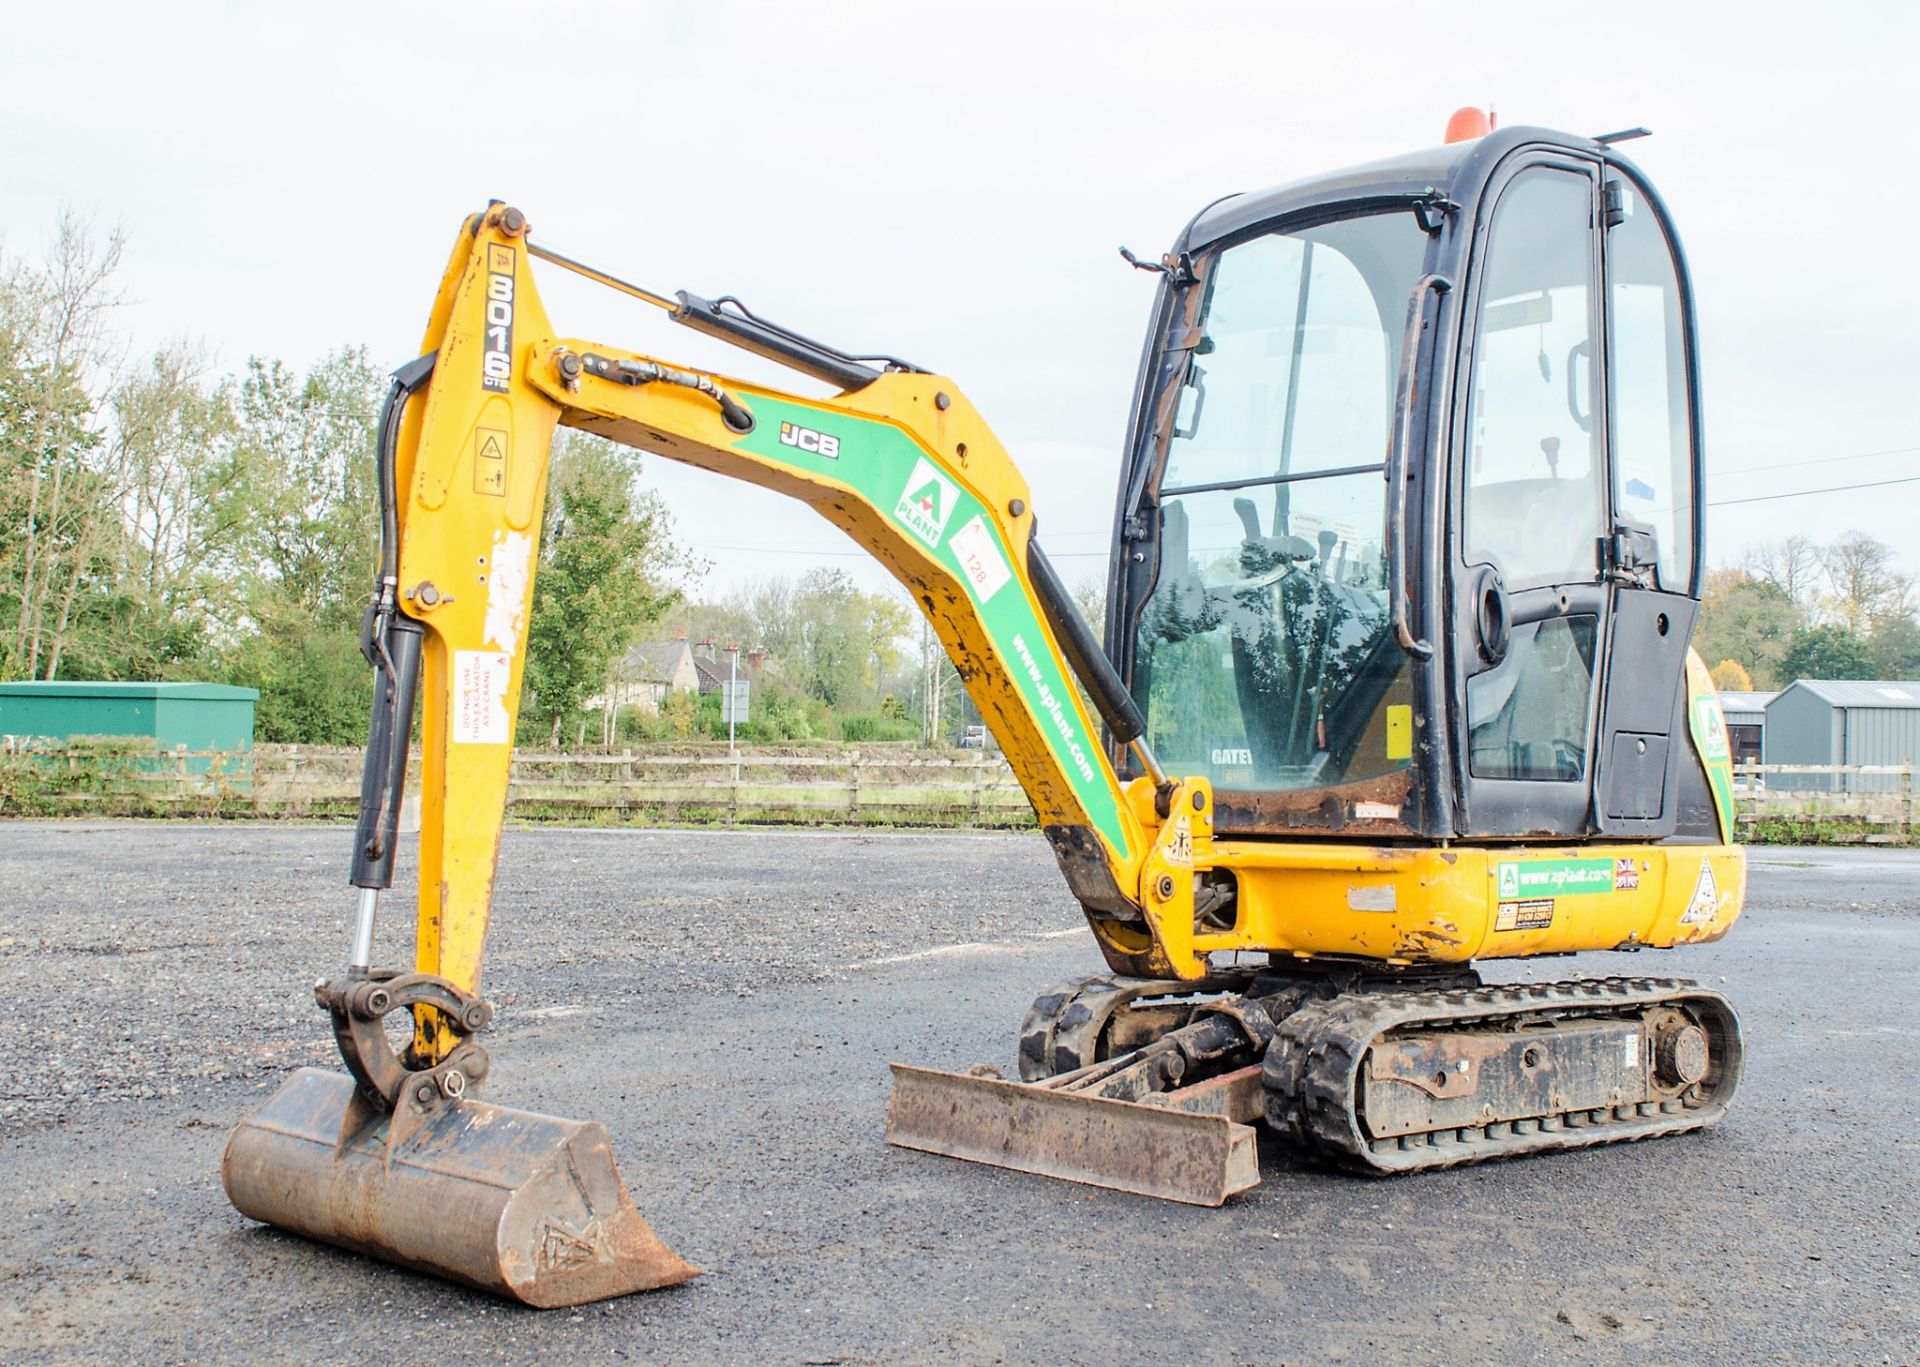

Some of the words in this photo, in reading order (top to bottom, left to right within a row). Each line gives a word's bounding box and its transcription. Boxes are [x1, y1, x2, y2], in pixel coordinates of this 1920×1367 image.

[484, 274, 513, 380] 8016
[780, 421, 840, 460] JCB
[909, 479, 943, 524] A
[898, 503, 940, 542] PLANT
[965, 552, 987, 584] 128
[472, 656, 480, 715] EXCAVATOR
[482, 670, 490, 703] CRANE
[463, 713, 470, 729] DO
[1012, 634, 1095, 784] www.aplant.com
